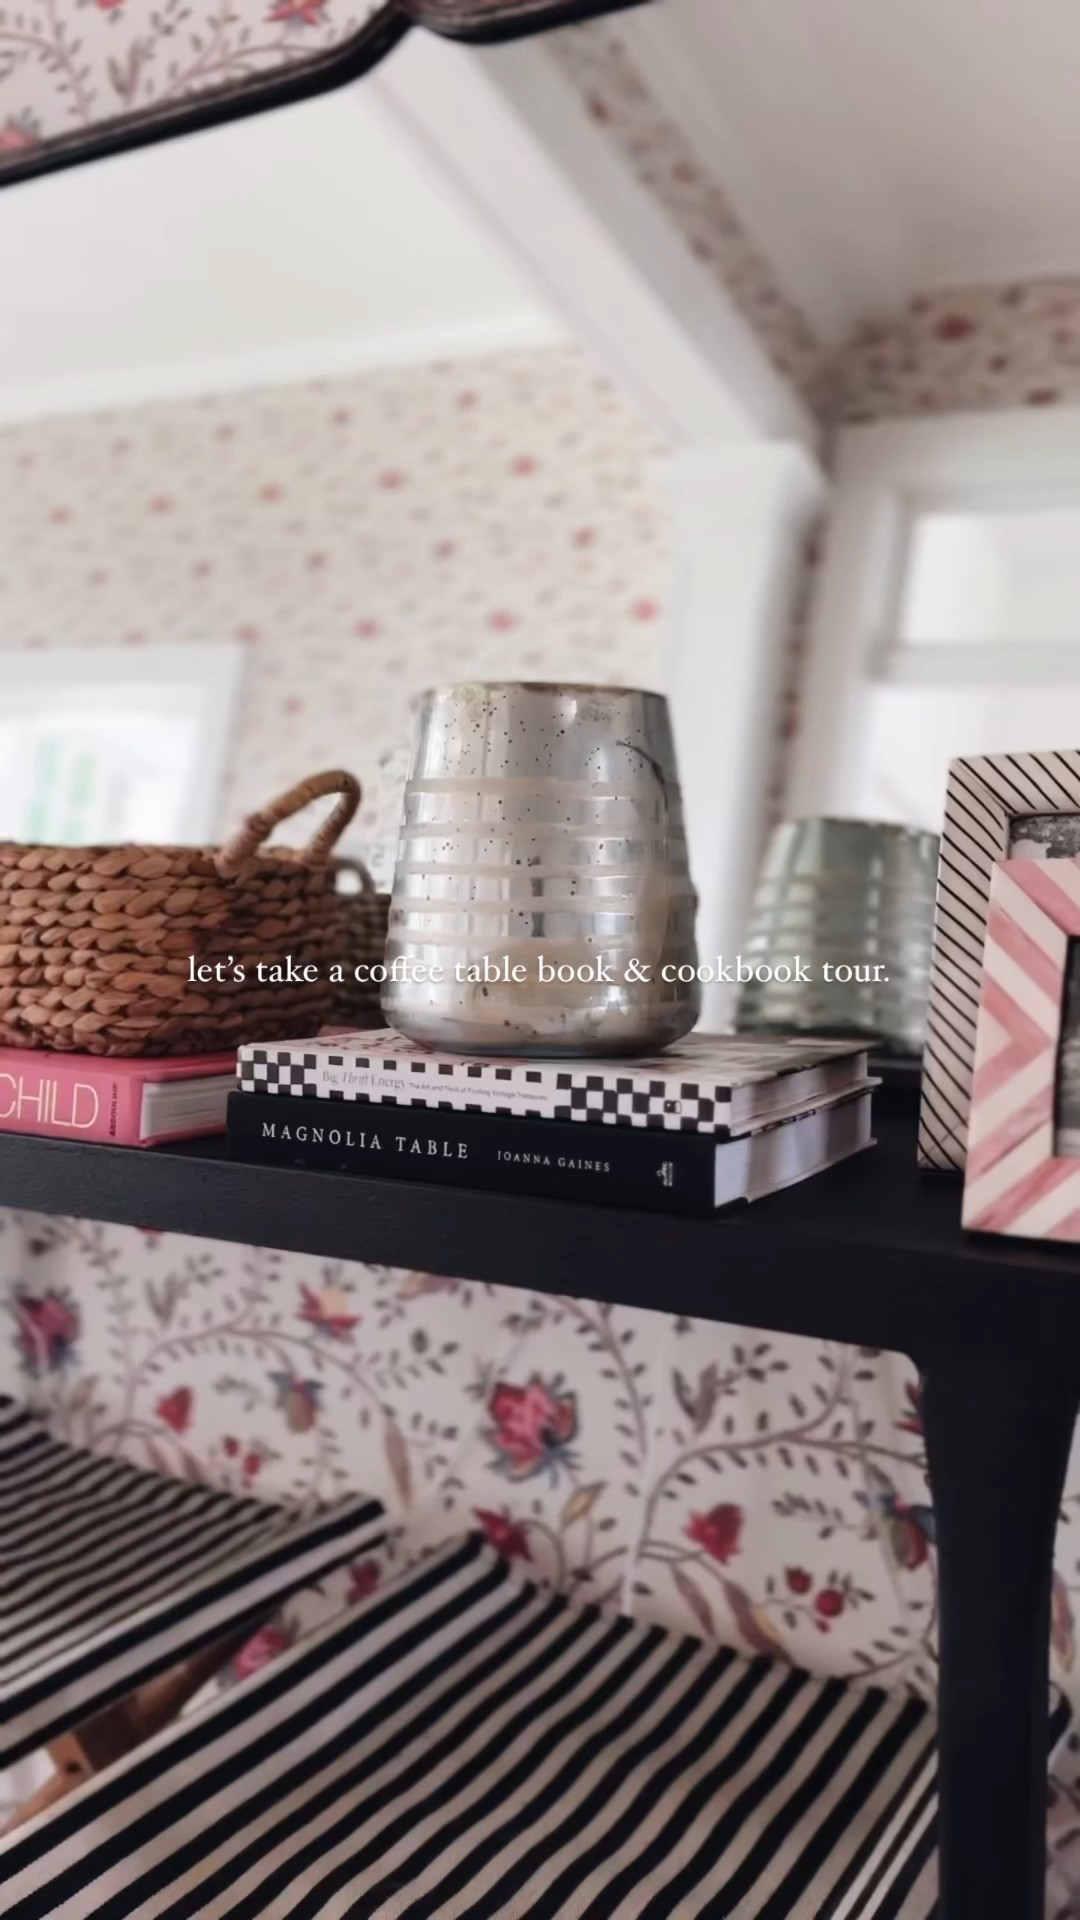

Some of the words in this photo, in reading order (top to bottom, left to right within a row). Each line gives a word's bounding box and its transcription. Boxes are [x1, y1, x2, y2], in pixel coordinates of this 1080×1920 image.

[322, 1070, 339, 1086] Big
[342, 1071, 369, 1086] Thrift
[371, 1073, 405, 1092] Energy
[409, 1082, 420, 1090] The
[0, 1073, 99, 1129] CHILD
[261, 1122, 382, 1150] MAGNOLIA
[395, 1136, 468, 1159] TABLE
[497, 1150, 551, 1166] JOANNA
[557, 1157, 611, 1173] GAINES
